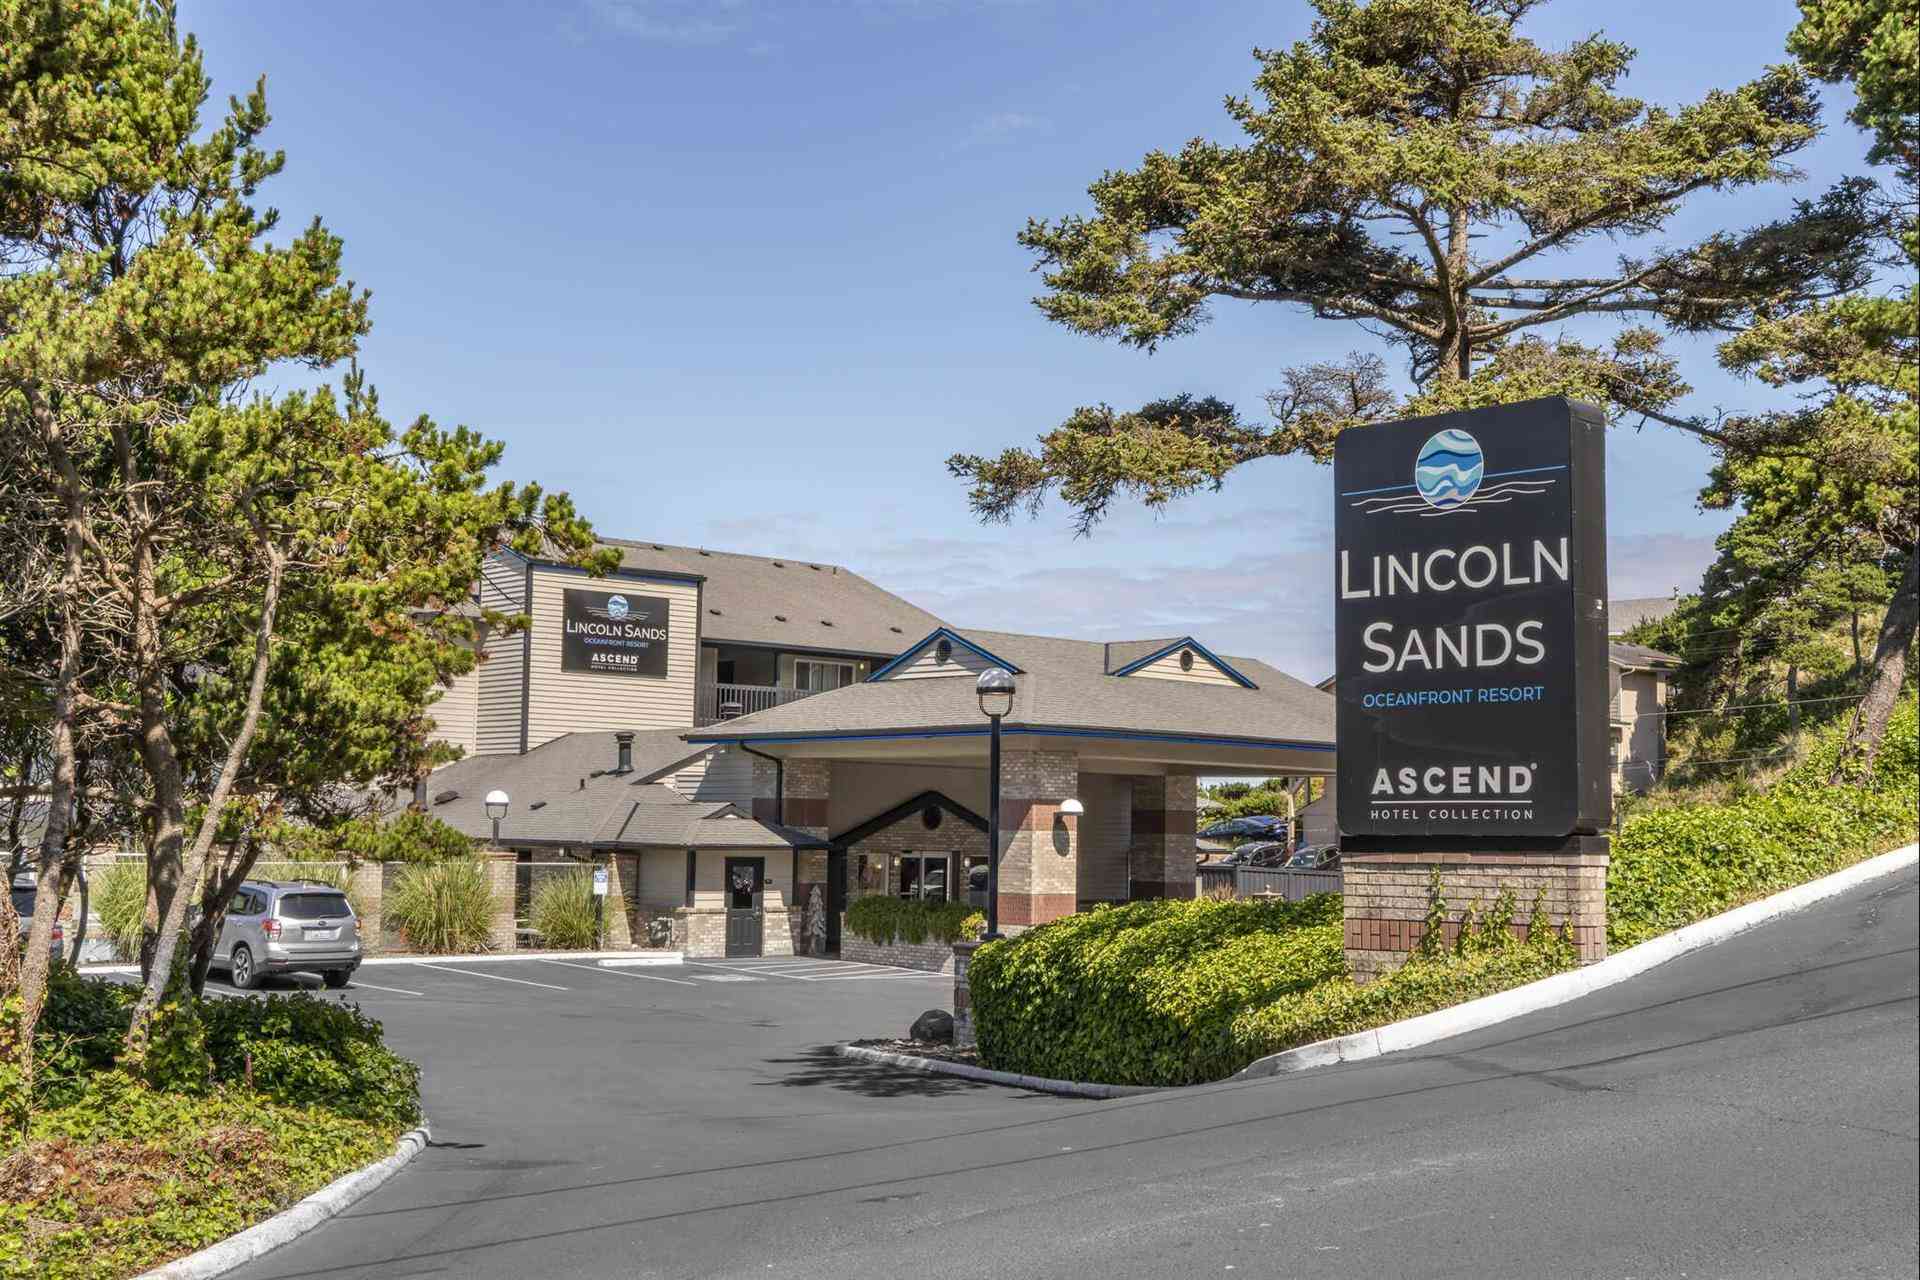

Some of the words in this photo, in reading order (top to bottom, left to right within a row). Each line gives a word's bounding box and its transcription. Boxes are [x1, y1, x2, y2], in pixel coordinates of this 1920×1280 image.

[1341, 537, 1569, 599] LINCOLN
[567, 619, 622, 636] LINCOLN
[625, 624, 666, 640] SANDS
[1362, 621, 1546, 672] SANDS
[592, 654, 638, 664] ASCEND
[1363, 689, 1473, 708] OCEANFRONT
[1478, 686, 1545, 703] RESORT
[1371, 764, 1536, 795] ASCEND
[1370, 809, 1419, 820] HOTEL
[1428, 809, 1534, 820] COLLECTION
